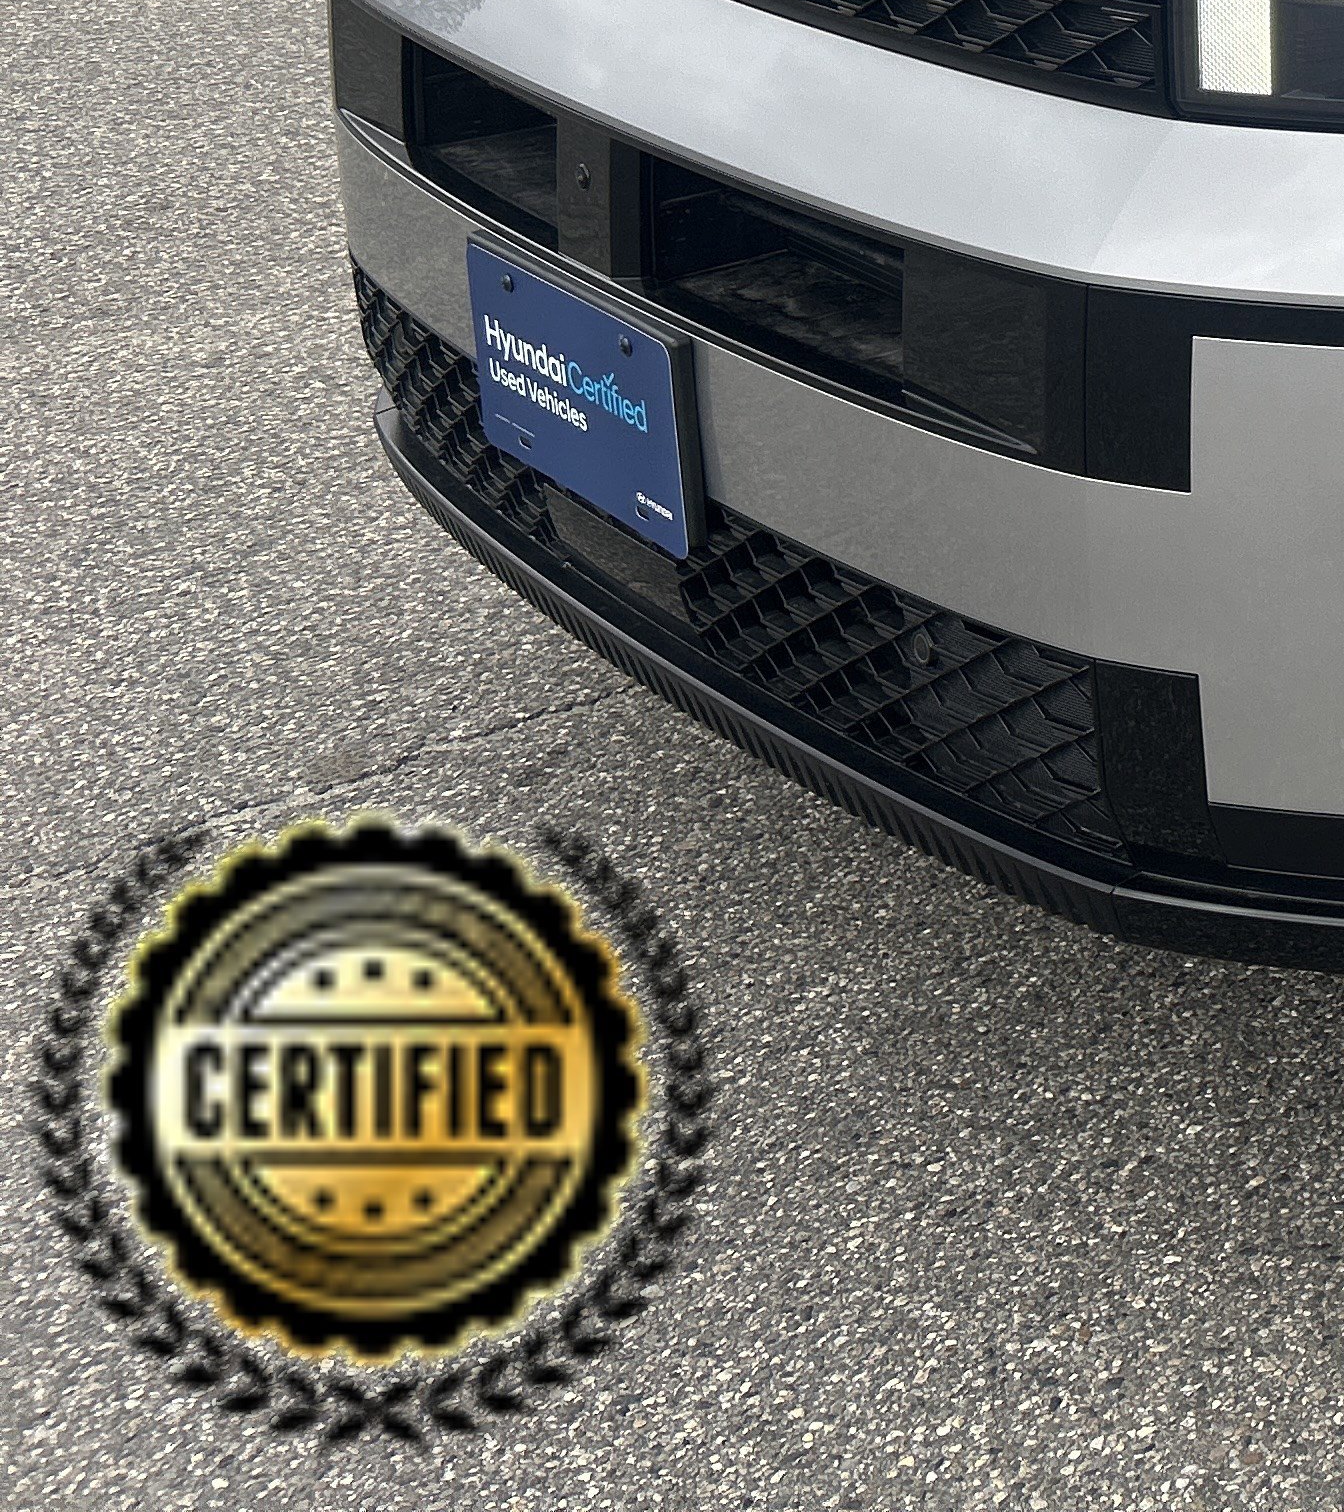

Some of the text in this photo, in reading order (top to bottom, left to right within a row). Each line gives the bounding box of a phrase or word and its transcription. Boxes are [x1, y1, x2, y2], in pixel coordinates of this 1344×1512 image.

[484, 314, 649, 433] Hyundai Certified
[489, 357, 527, 397] Used
[526, 378, 588, 432] Vehicles
